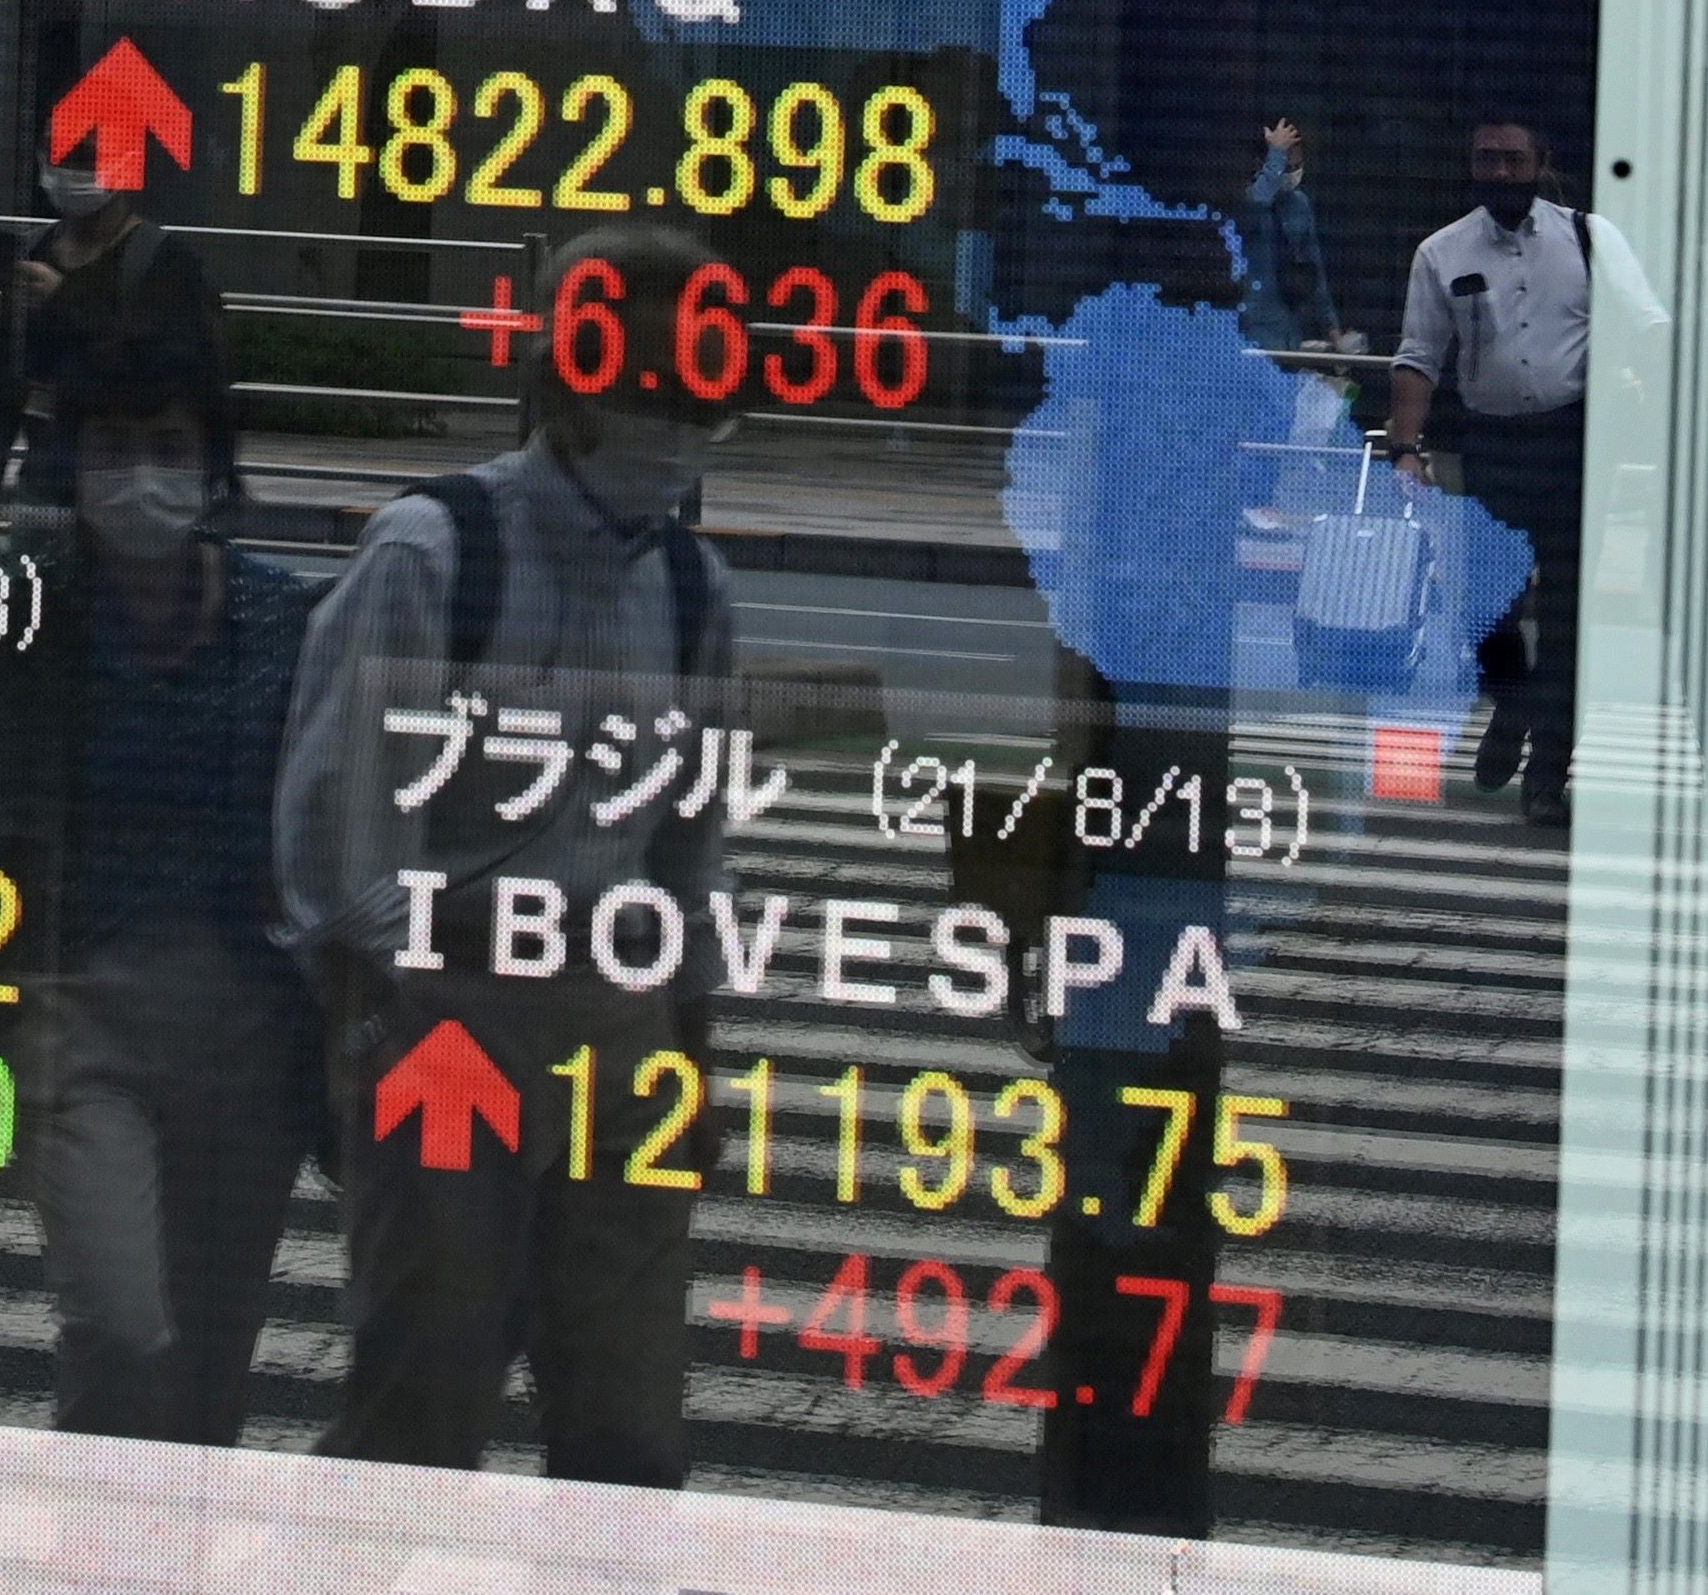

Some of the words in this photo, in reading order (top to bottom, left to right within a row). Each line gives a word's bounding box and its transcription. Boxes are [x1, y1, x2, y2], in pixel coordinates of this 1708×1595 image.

[220, 60, 937, 224] 14822.898
[460, 256, 930, 408] +6.636
[384, 690, 788, 827] ブラジル
[395, 867, 1243, 1030] IBOVESPA
[545, 1044, 1289, 1237] 121193.75
[708, 1252, 1284, 1425] +492.77
